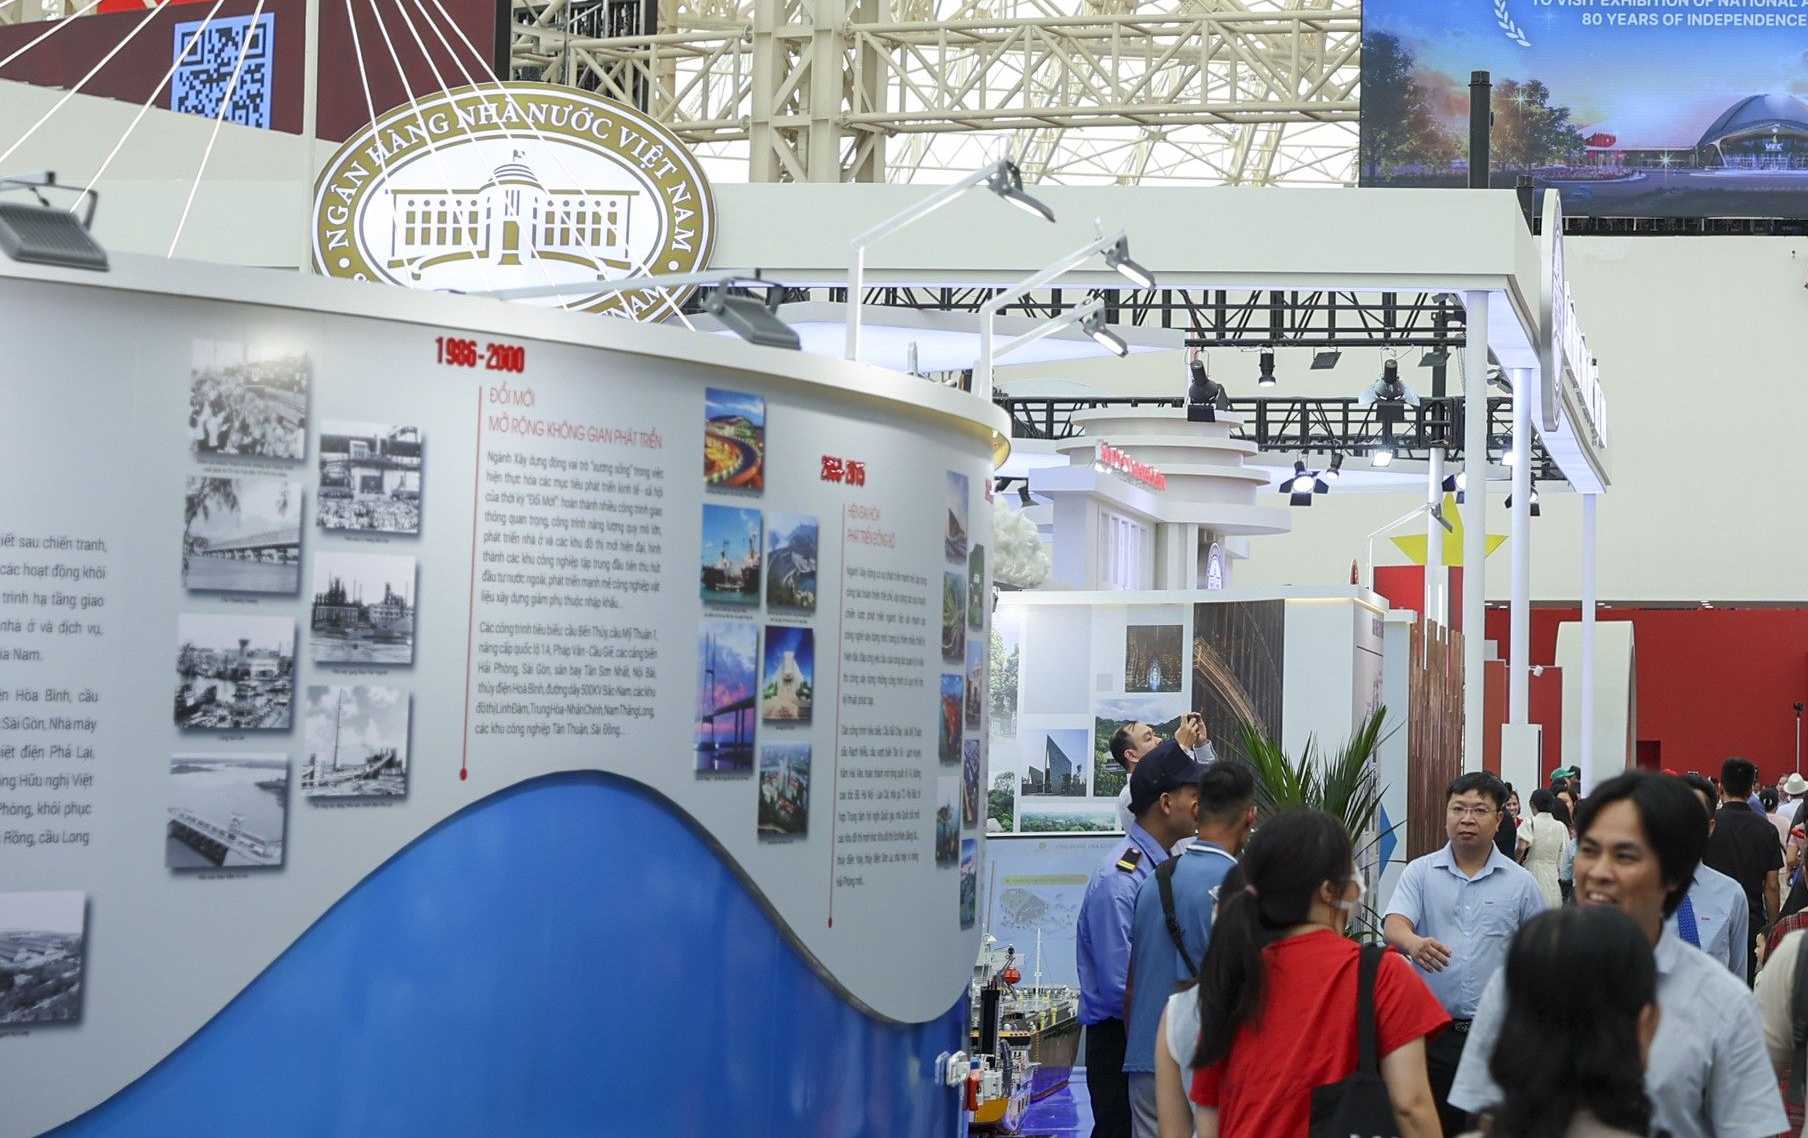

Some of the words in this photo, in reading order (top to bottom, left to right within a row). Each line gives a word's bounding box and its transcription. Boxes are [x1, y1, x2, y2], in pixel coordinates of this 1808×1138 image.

[1582, 13, 1602, 26] 80
[1606, 13, 1659, 26] YEARS
[1662, 13, 1683, 26] OF
[1687, 13, 1807, 27] INDEPENDENCE
[326, 165, 370, 251] NGÂN
[365, 112, 450, 167] HÀNG
[456, 97, 520, 130] NHÀ
[528, 102, 613, 140] NƯỚC
[618, 126, 677, 179] VIỆT
[666, 180, 695, 253] NAM
[435, 336, 525, 373] 1986-2000
[490, 381, 510, 404] ĐỔI
[513, 388, 535, 407] MỚI
[489, 411, 509, 433] MỞ
[511, 418, 544, 438] RỘNG
[547, 420, 585, 441] KHÔNG
[587, 425, 612, 444] GIAN
[614, 426, 637, 446] PHÁT
[639, 426, 662, 449] TRIỂN
[19, 536, 39, 548] sau
[42, 534, 72, 550] chiến
[76, 538, 107, 553] tranh,
[23, 563, 48, 579] hoạt
[52, 564, 79, 581] động
[3, 591, 28, 604] trình
[33, 591, 47, 607] hạ
[52, 589, 76, 609] tầng
[81, 594, 104, 609] giao
[27, 617, 35, 634] ở
[40, 619, 53, 634] và
[58, 619, 82, 636] dịch
[87, 622, 103, 637] vụ,
[13, 648, 43, 661] Nam.
[16, 688, 38, 702] Hòa
[45, 688, 72, 704] Bình,
[78, 687, 98, 703] cầu
[2, 716, 20, 730] Sài
[22, 717, 47, 732] Gòn,
[49, 717, 72, 730] Nhà
[73, 719, 97, 734] máy
[20, 745, 44, 760] điện
[50, 745, 71, 759] Phả
[76, 745, 95, 761] Lại,
[19, 772, 42, 788] Hữu
[45, 775, 69, 791] nghị
[72, 772, 93, 788] Việt
[64, 804, 92, 818] phục
[4, 829, 36, 847] Rồng,
[39, 830, 59, 844] cầu
[62, 830, 89, 846] Long
